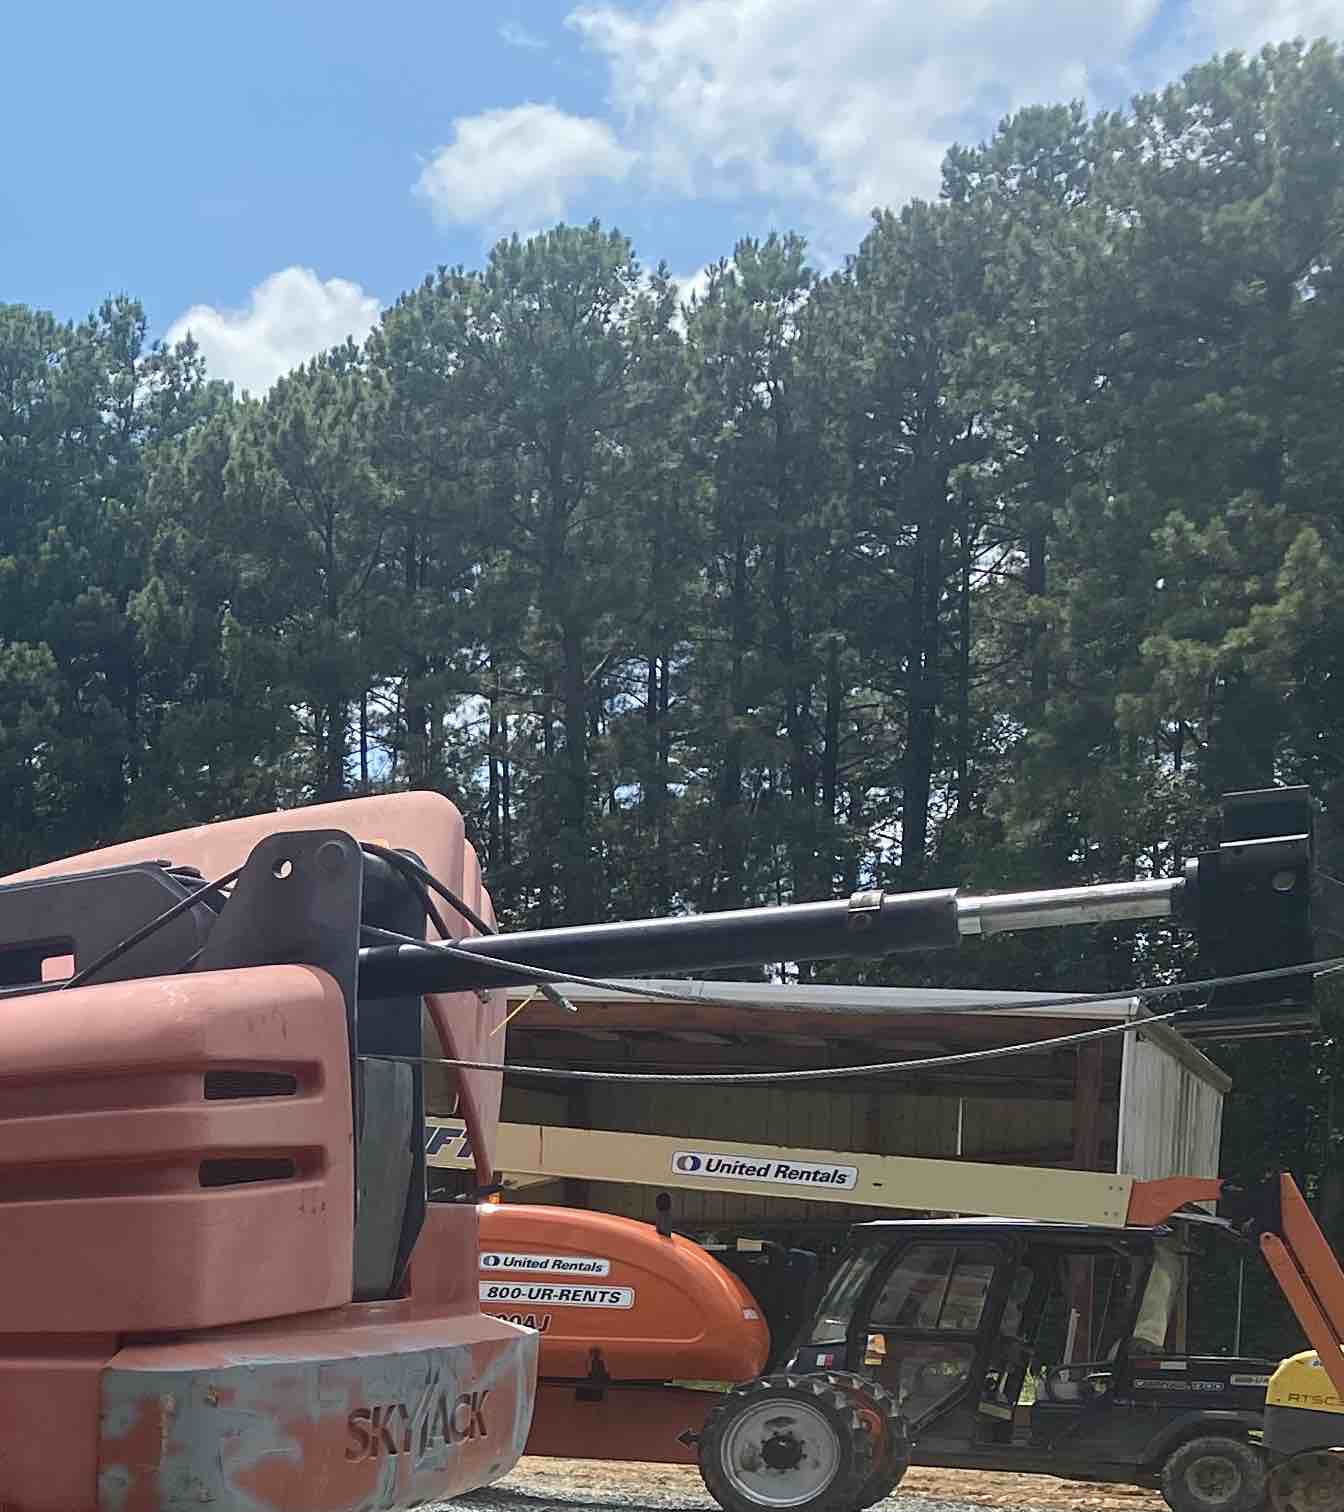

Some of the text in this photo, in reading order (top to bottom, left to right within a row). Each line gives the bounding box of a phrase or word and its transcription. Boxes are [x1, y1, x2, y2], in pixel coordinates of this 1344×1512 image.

[705, 1157, 848, 1185] United Rentals
[503, 1256, 603, 1273] United Rentals
[487, 1286, 622, 1304] 800-UR-RENTS
[344, 1366, 490, 1467] SKYJACK
